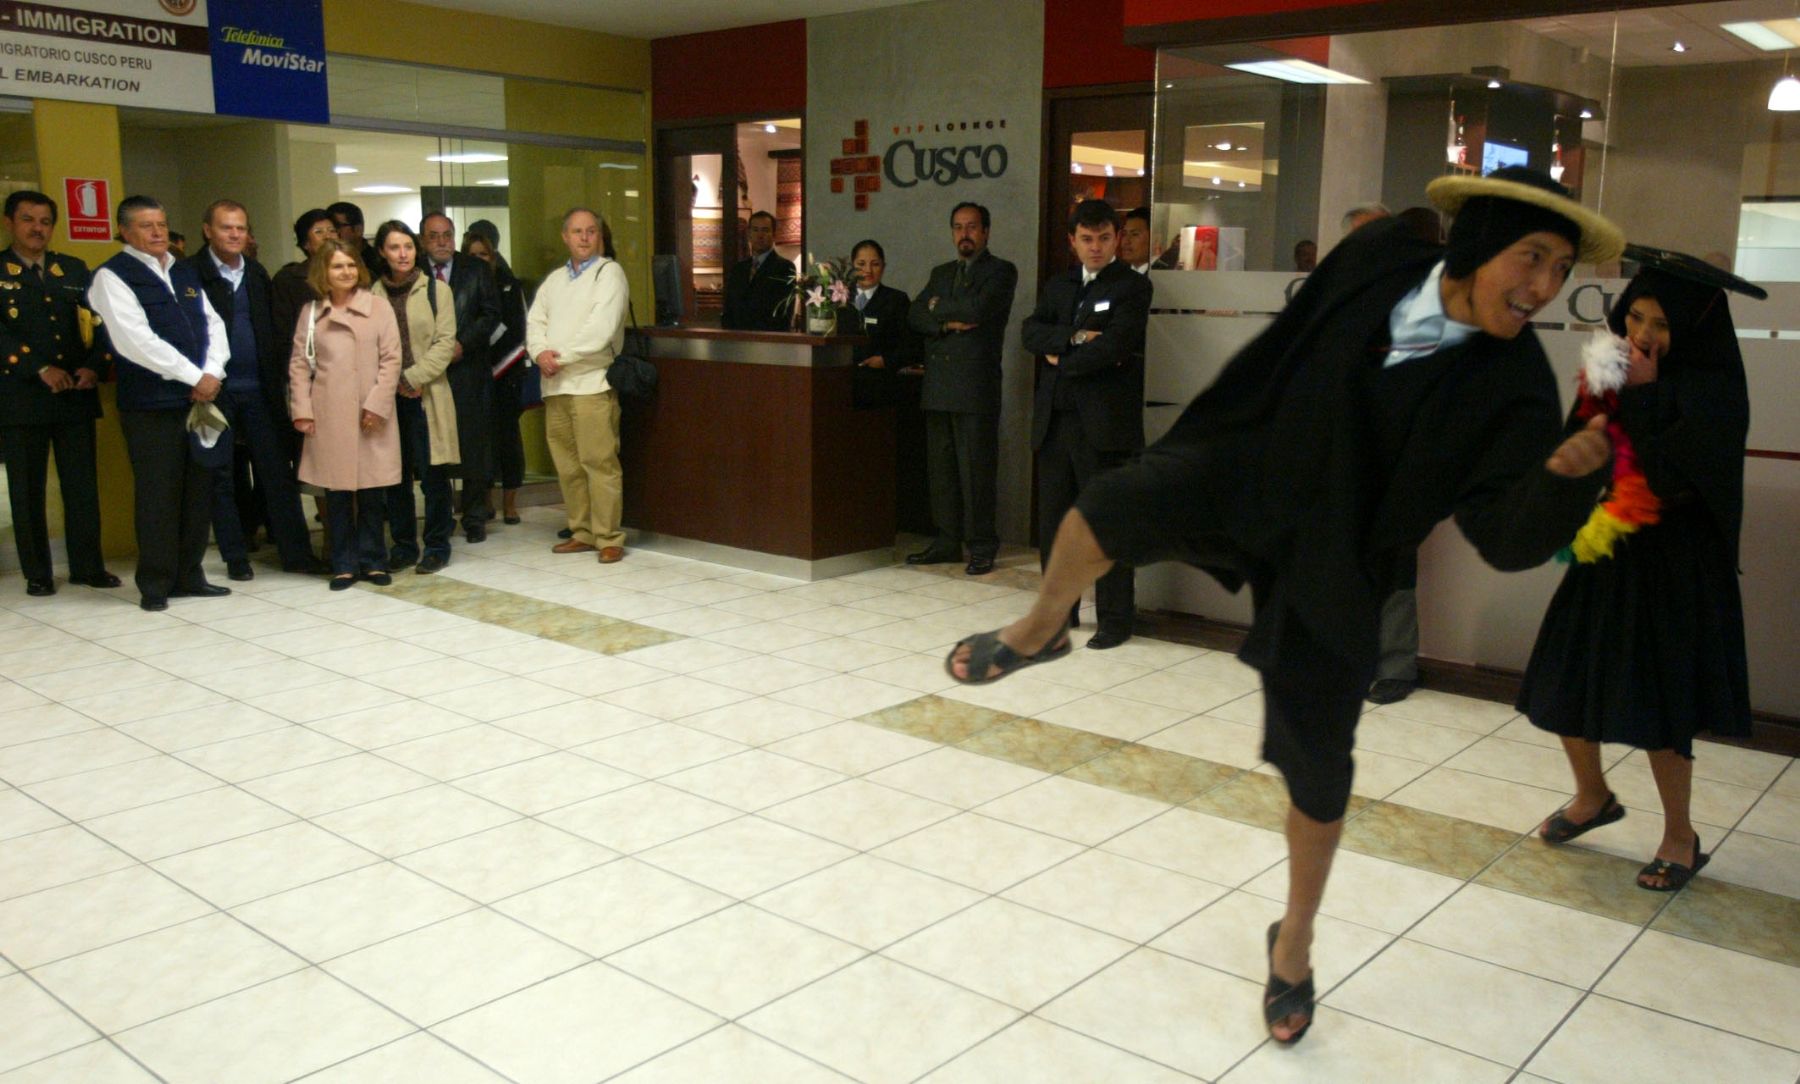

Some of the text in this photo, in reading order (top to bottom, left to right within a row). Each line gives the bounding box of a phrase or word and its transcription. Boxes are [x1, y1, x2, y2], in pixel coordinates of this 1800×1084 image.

[17, 8, 177, 46] IMMIGRATION
[0, 42, 152, 70] IGRATORIO CUSCO PERU
[242, 48, 324, 73] MoviStar
[15, 67, 141, 92] EMBARKATION
[935, 120, 1006, 133] LOUNGE
